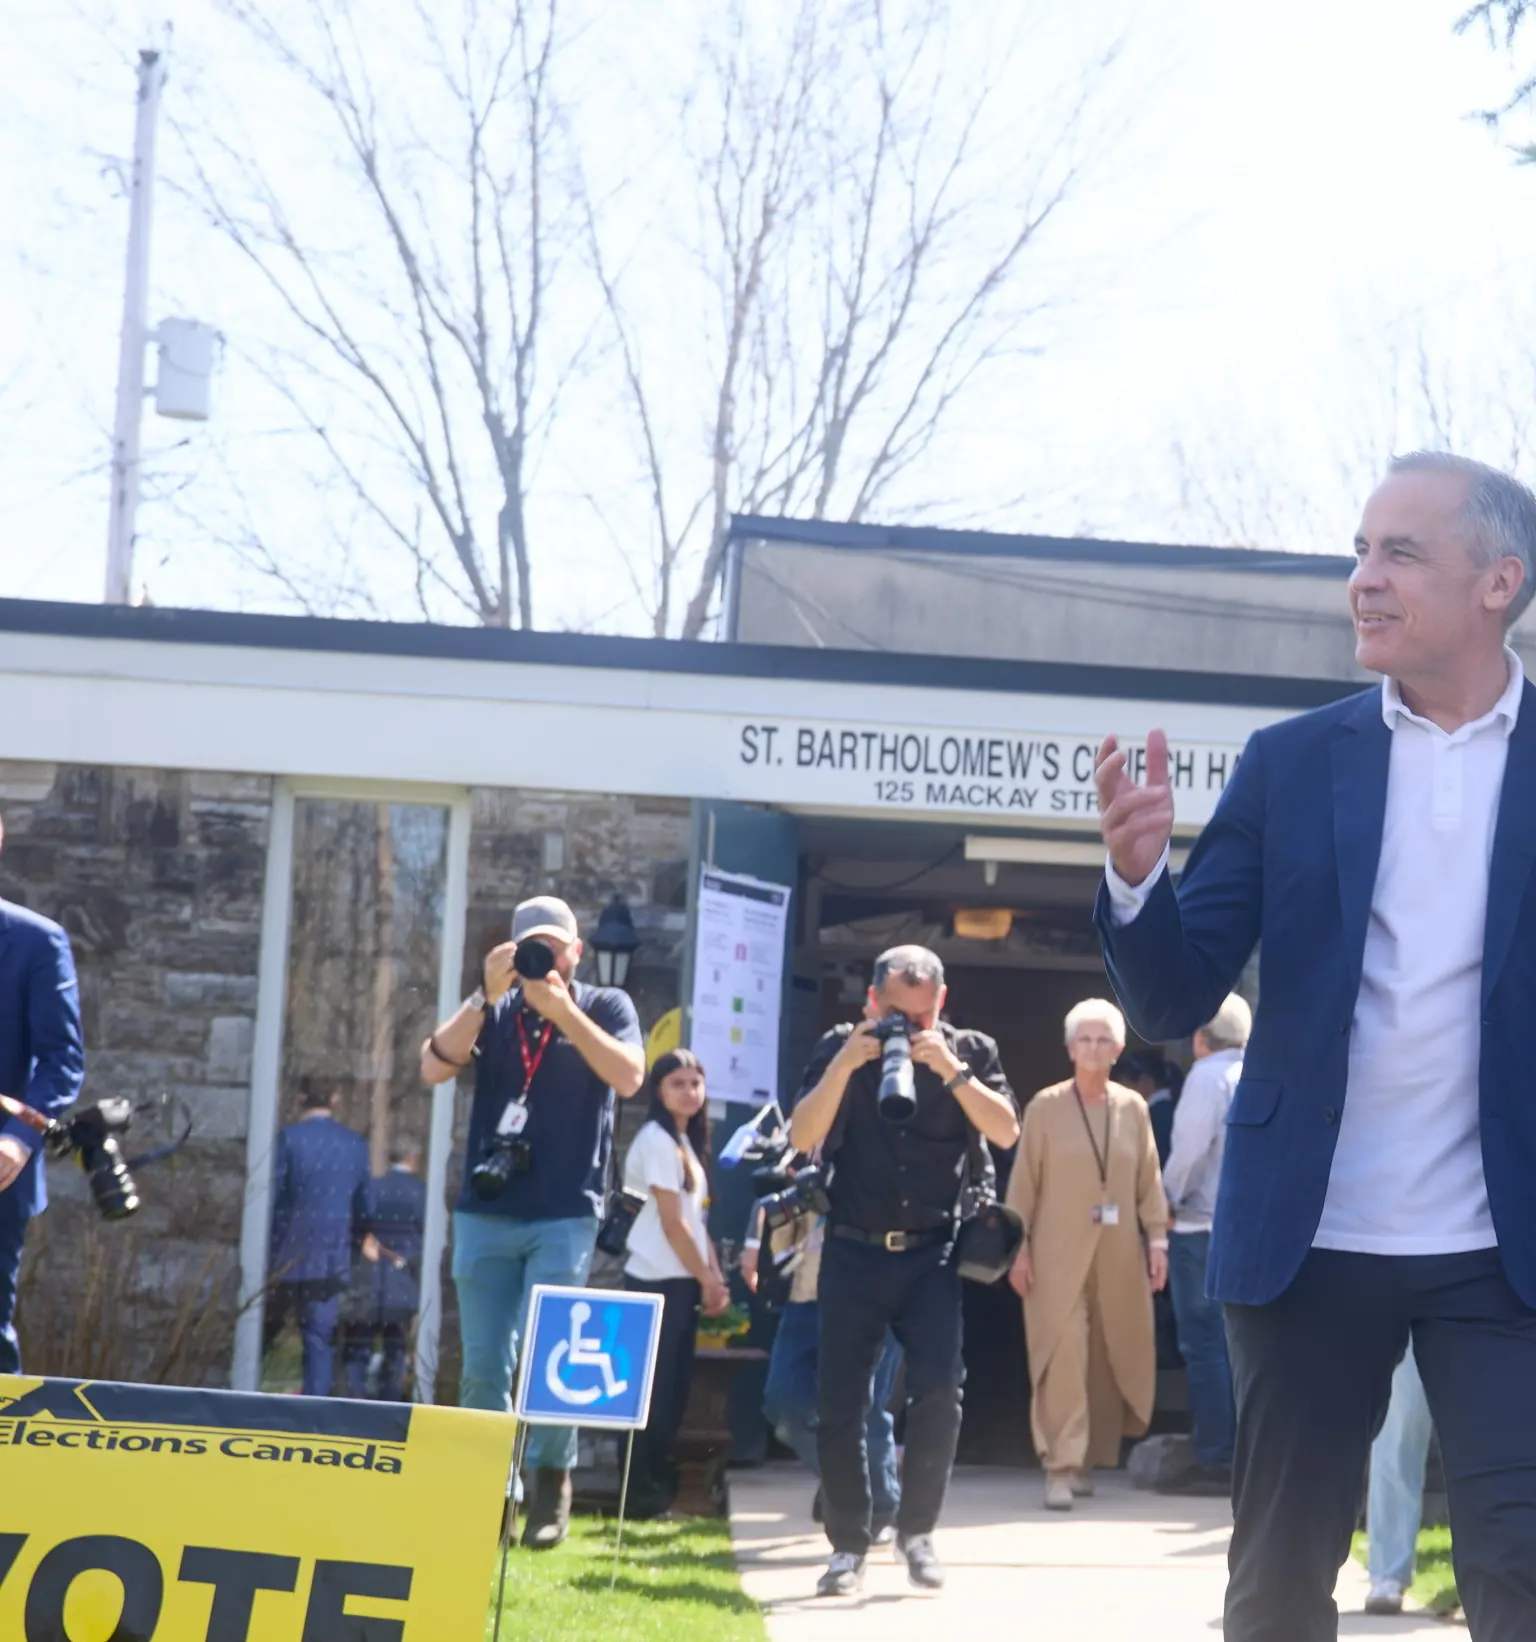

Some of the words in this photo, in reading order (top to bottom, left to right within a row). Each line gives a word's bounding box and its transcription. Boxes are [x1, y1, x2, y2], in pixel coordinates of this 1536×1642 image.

[740, 725, 782, 766] ST.
[797, 728, 1060, 782] BARTHOLOMEW'S
[874, 780, 914, 803] 125
[926, 782, 1039, 808] MACKAY
[220, 1437, 403, 1474] Canada
